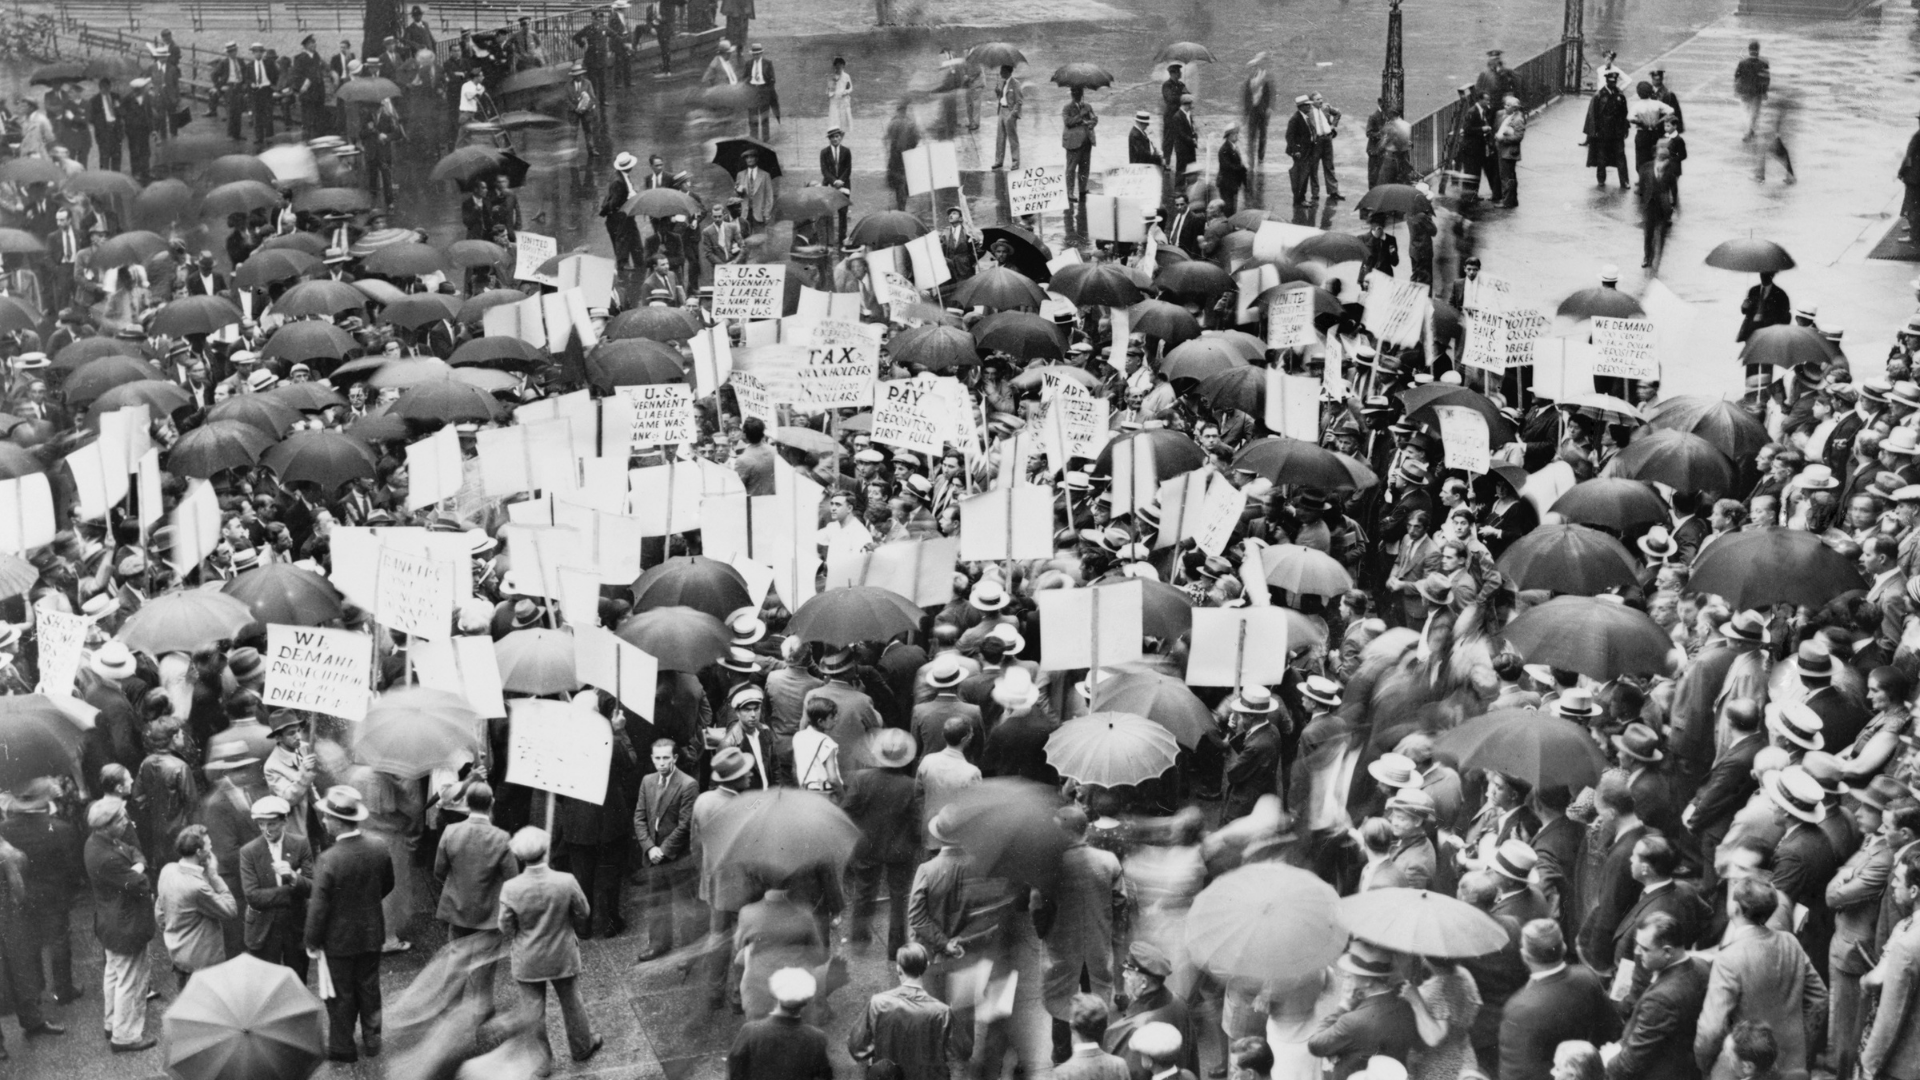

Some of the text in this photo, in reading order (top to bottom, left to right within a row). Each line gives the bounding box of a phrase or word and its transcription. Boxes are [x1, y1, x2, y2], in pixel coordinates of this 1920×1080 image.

[1023, 167, 1045, 180] NO
[1011, 174, 1063, 190] EVICTIONS
[1024, 200, 1050, 212] RENT
[717, 279, 782, 287] GOVERNMENT
[730, 288, 772, 298] LIABLE
[728, 298, 750, 306] NAME
[754, 297, 775, 306] WAS
[715, 307, 739, 316] BANK
[1464, 307, 1503, 328] WE WANT
[1595, 319, 1654, 333] WE DEMAND
[808, 347, 857, 365] TAX
[1605, 356, 1637, 366] SMALL
[1044, 372, 1061, 388] WE
[887, 385, 925, 407] PAY
[636, 409, 675, 420] LIABLE
[885, 402, 927, 419] SMALL
[664, 418, 686, 428] WAS
[876, 411, 936, 434] DEPOSITORS
[632, 432, 652, 441] ANK
[874, 426, 933, 445] FIRST FULL
[294, 631, 330, 650] WE
[278, 645, 356, 669] DEMAND
